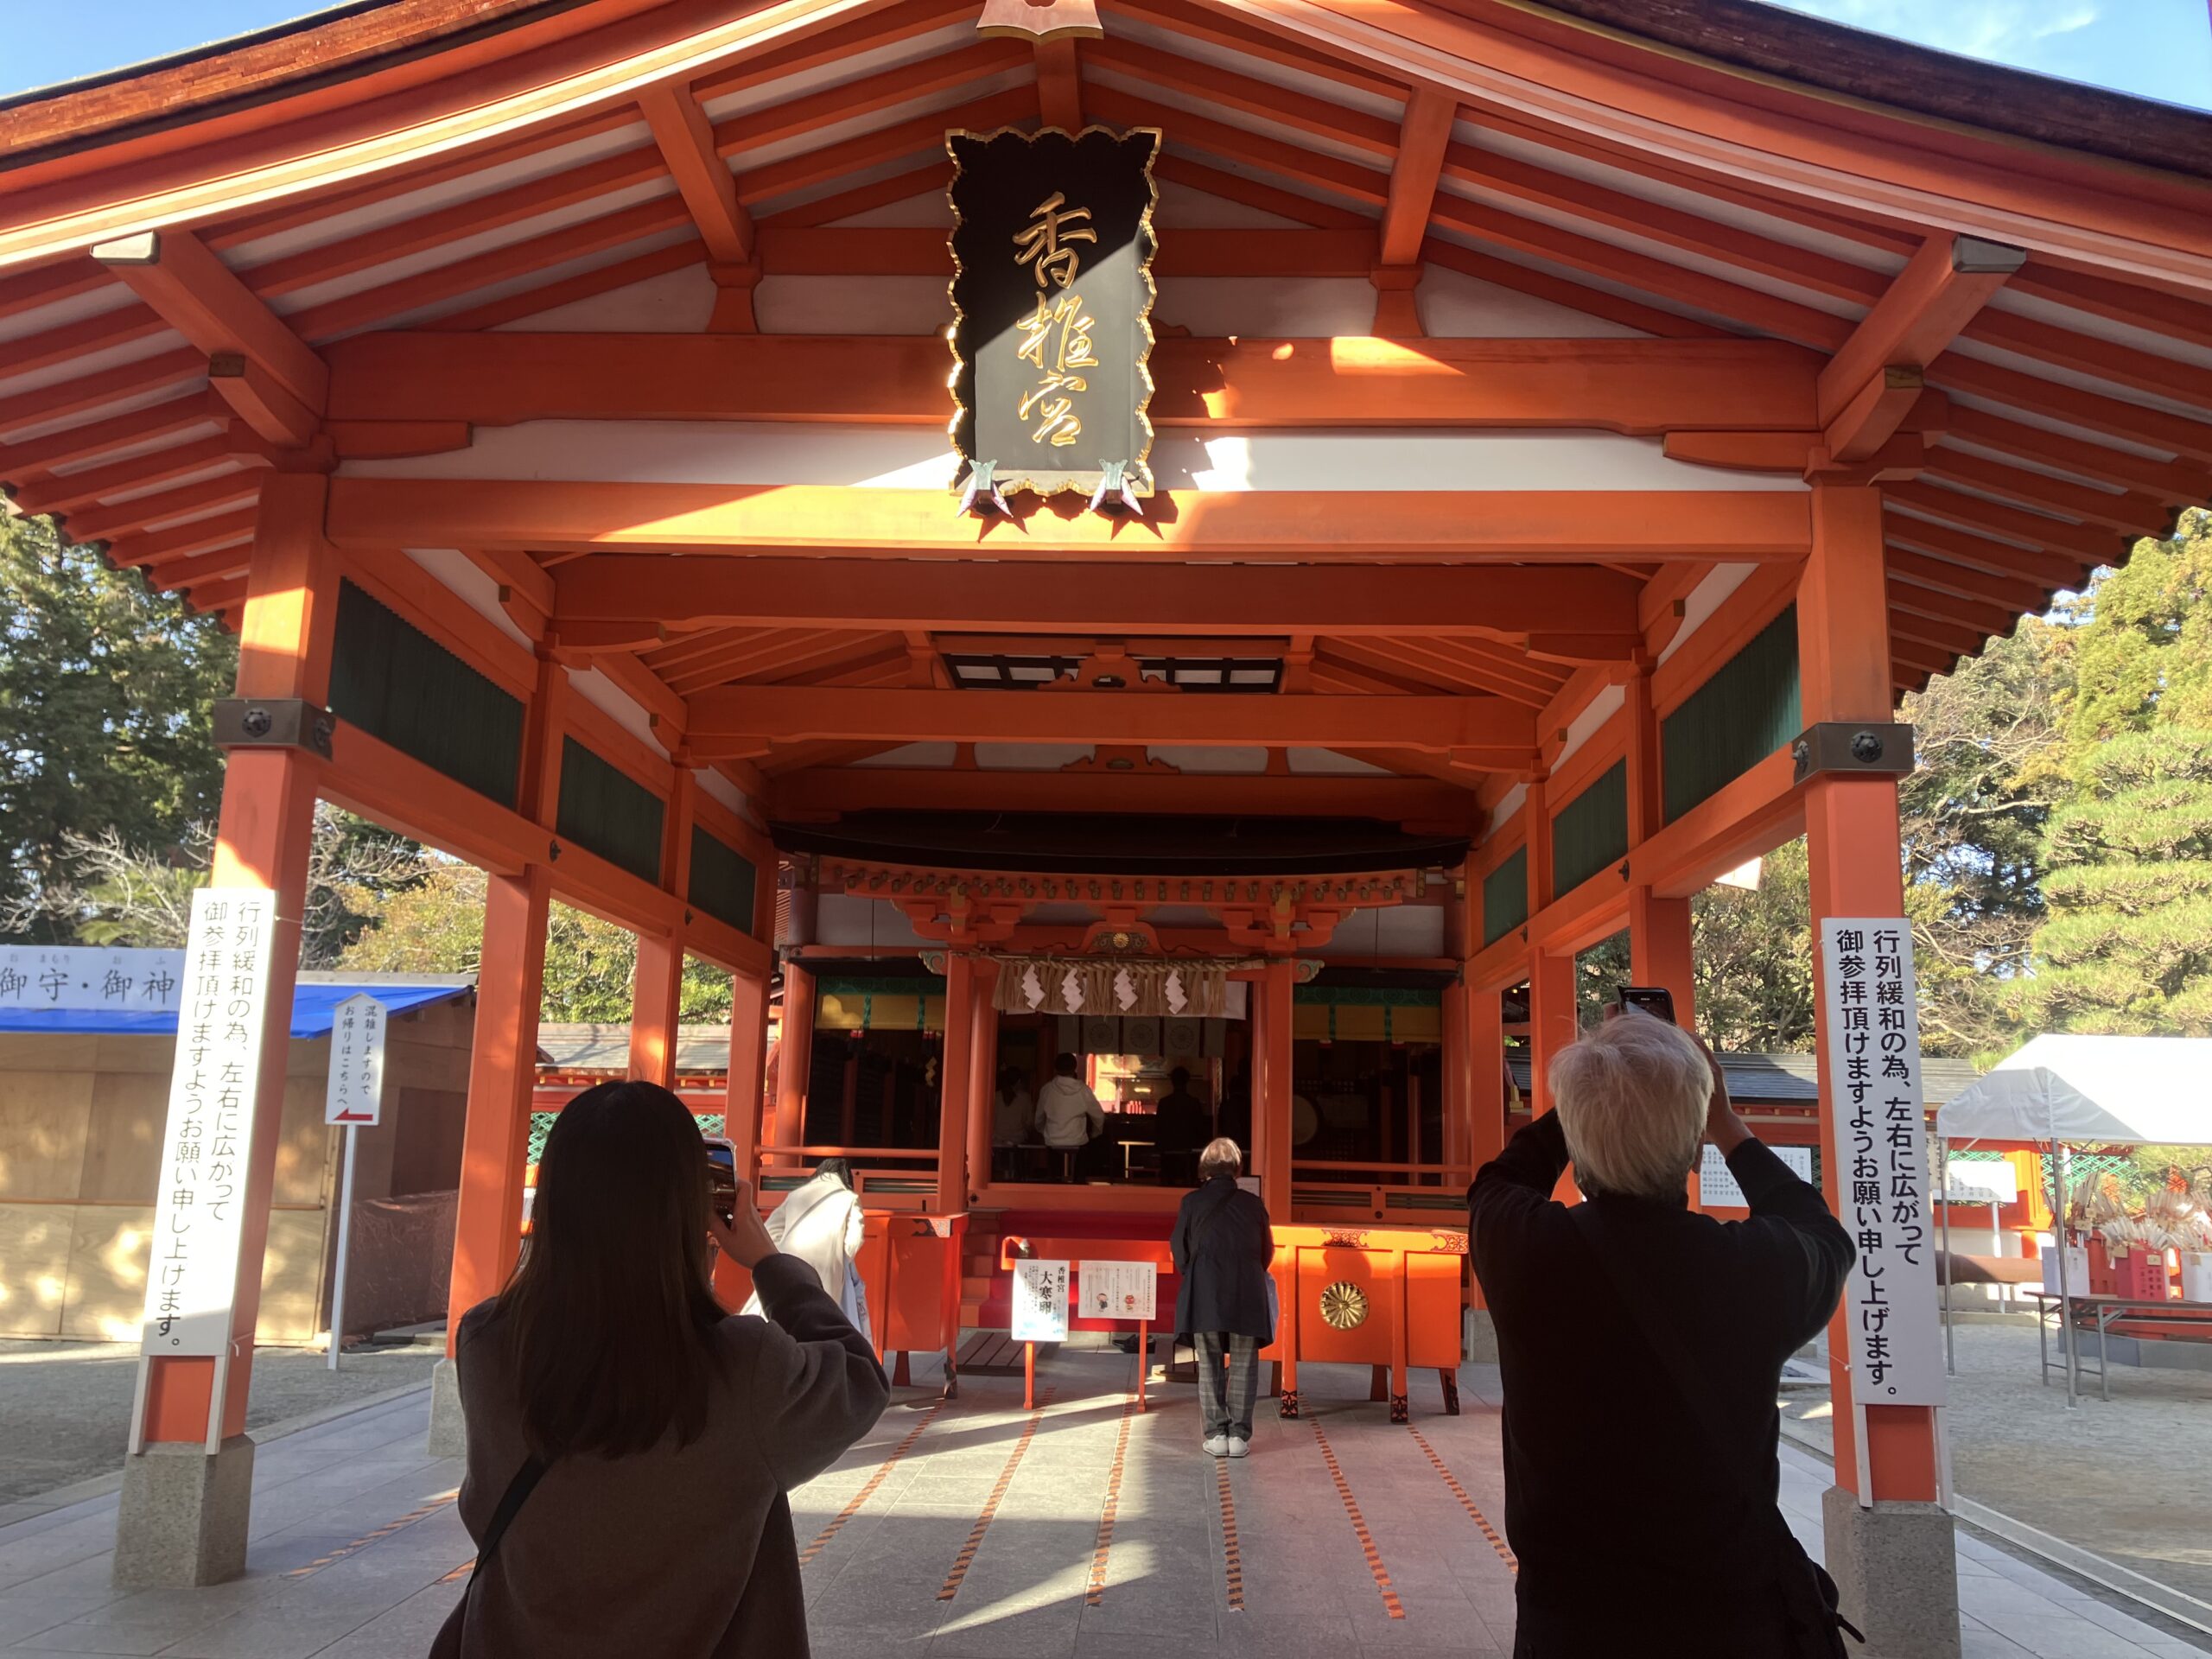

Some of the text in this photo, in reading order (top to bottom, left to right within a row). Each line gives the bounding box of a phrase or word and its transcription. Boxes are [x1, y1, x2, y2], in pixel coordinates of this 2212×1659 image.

[1012, 191, 1099, 448] 香椎宮
[206, 901, 262, 1221] 行列緩和の為、左右に広がって
[337, 1005, 355, 1105] お帰りはこちらへ
[360, 1005, 378, 1095] 混雑しますので
[1836, 929, 1897, 1395] 御参拝頂けますようお願い申し上げます。
[1873, 930, 1923, 1265] 行列緩和の為、左右に広がって
[1039, 1270, 1053, 1315] 大寒卵
